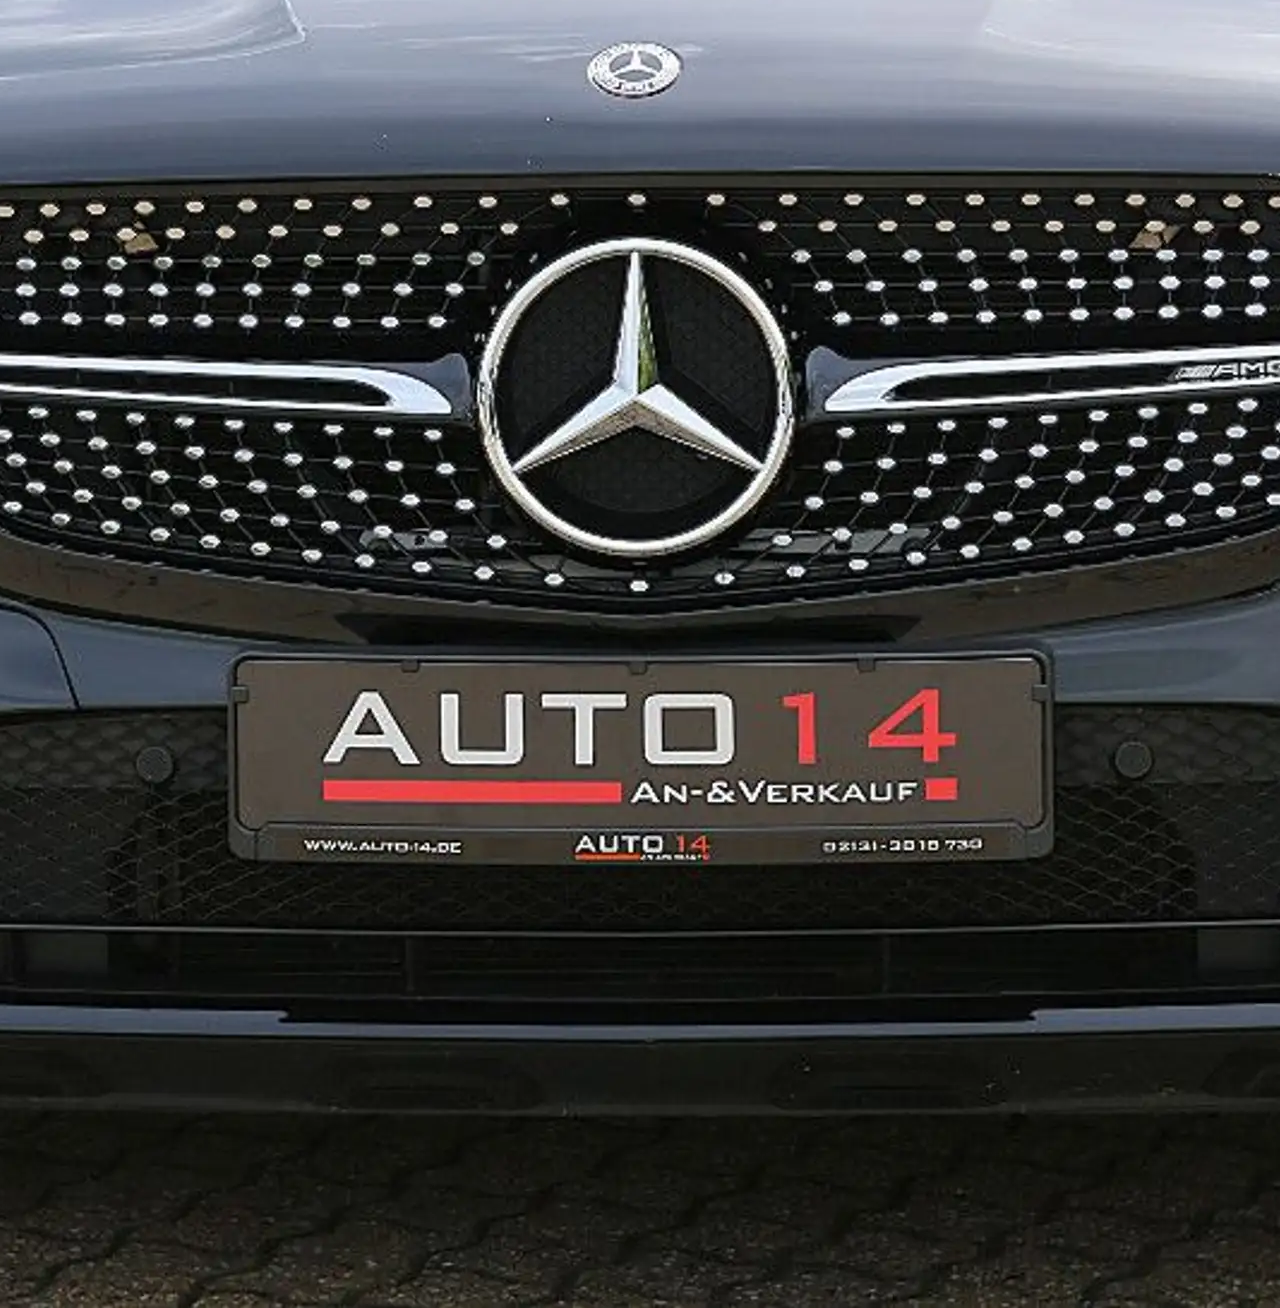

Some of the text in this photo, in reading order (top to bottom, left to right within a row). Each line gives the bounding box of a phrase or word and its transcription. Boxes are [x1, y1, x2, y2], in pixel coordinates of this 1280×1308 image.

[322, 689, 957, 766] AUTO 14
[575, 834, 710, 854] AUTO 14
